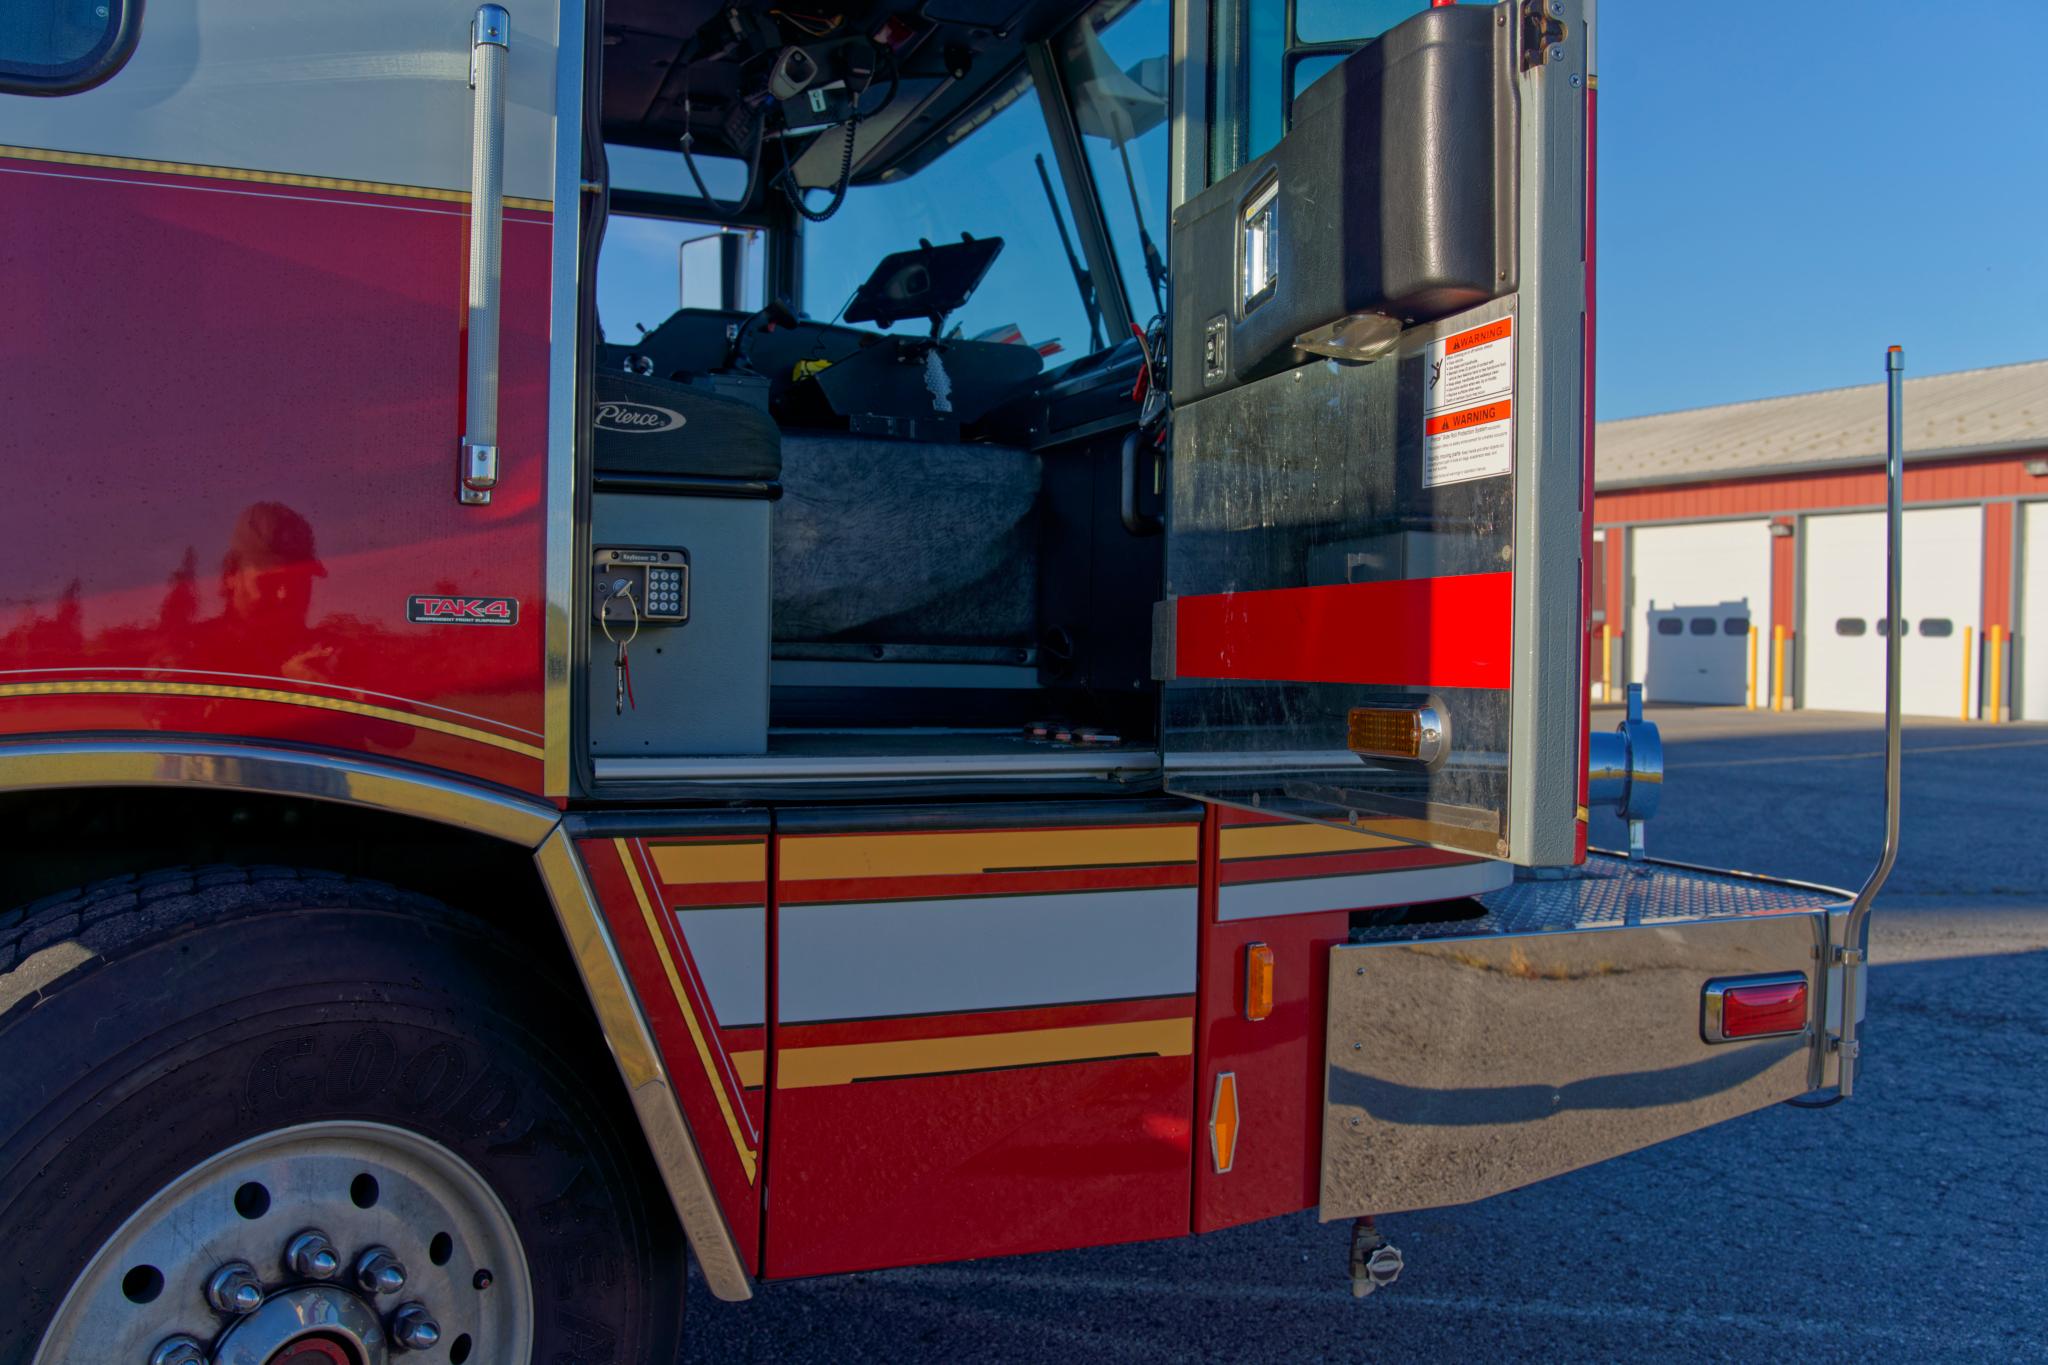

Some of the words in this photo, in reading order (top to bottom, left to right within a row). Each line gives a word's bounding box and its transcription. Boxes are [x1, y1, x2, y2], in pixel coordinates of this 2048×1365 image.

[1460, 326, 1503, 347] WARNING
[595, 405, 660, 426] Pierce
[1452, 407, 1496, 427] WARNING
[415, 598, 511, 618] TAK-4
